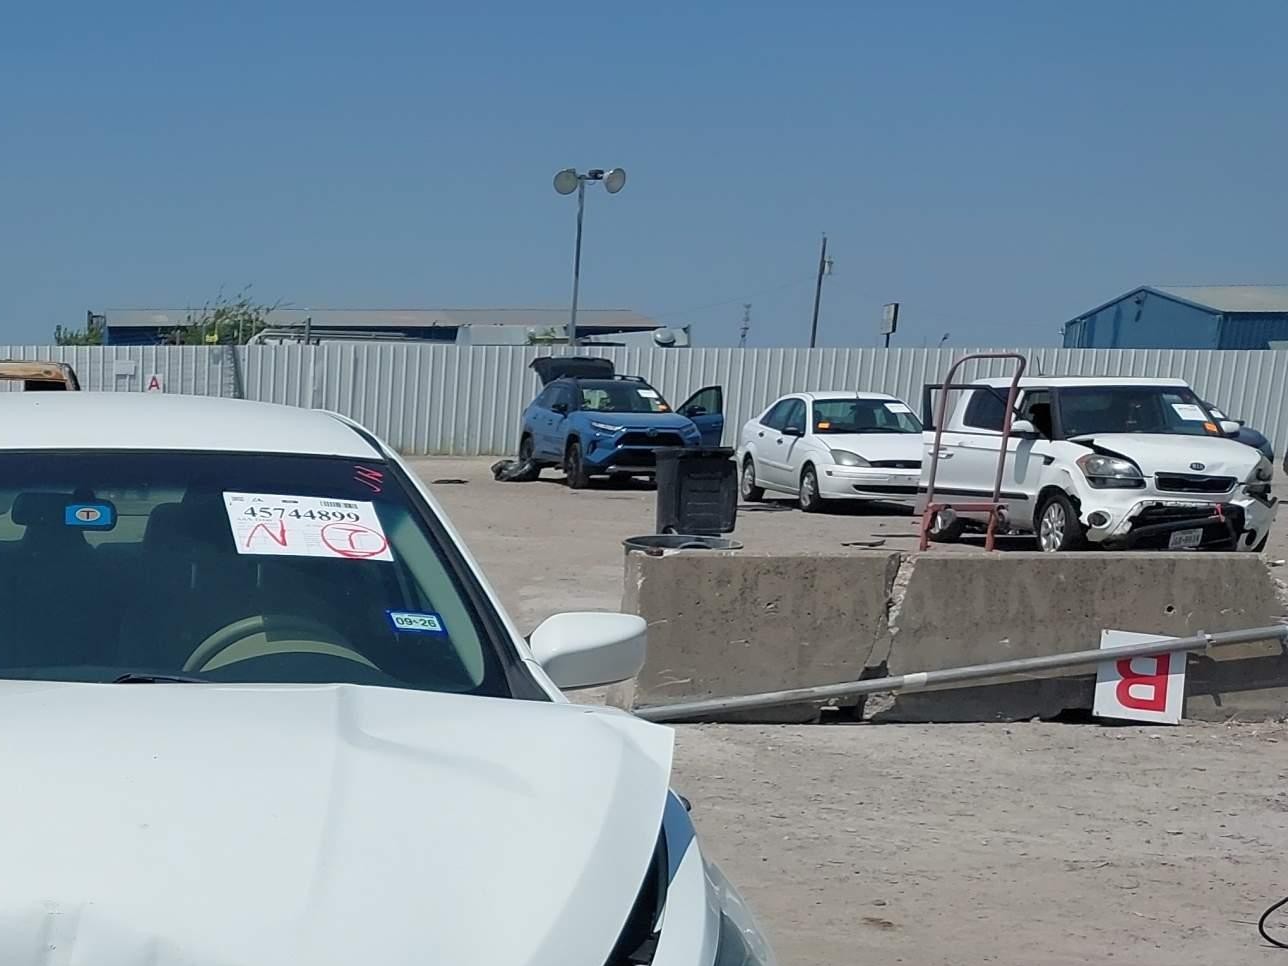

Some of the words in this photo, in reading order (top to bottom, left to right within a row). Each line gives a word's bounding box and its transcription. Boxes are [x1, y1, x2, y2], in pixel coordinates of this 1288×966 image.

[148, 375, 160, 390] A
[80, 510, 97, 520] T
[243, 506, 361, 523] 45744899
[1116, 652, 1171, 713] B
